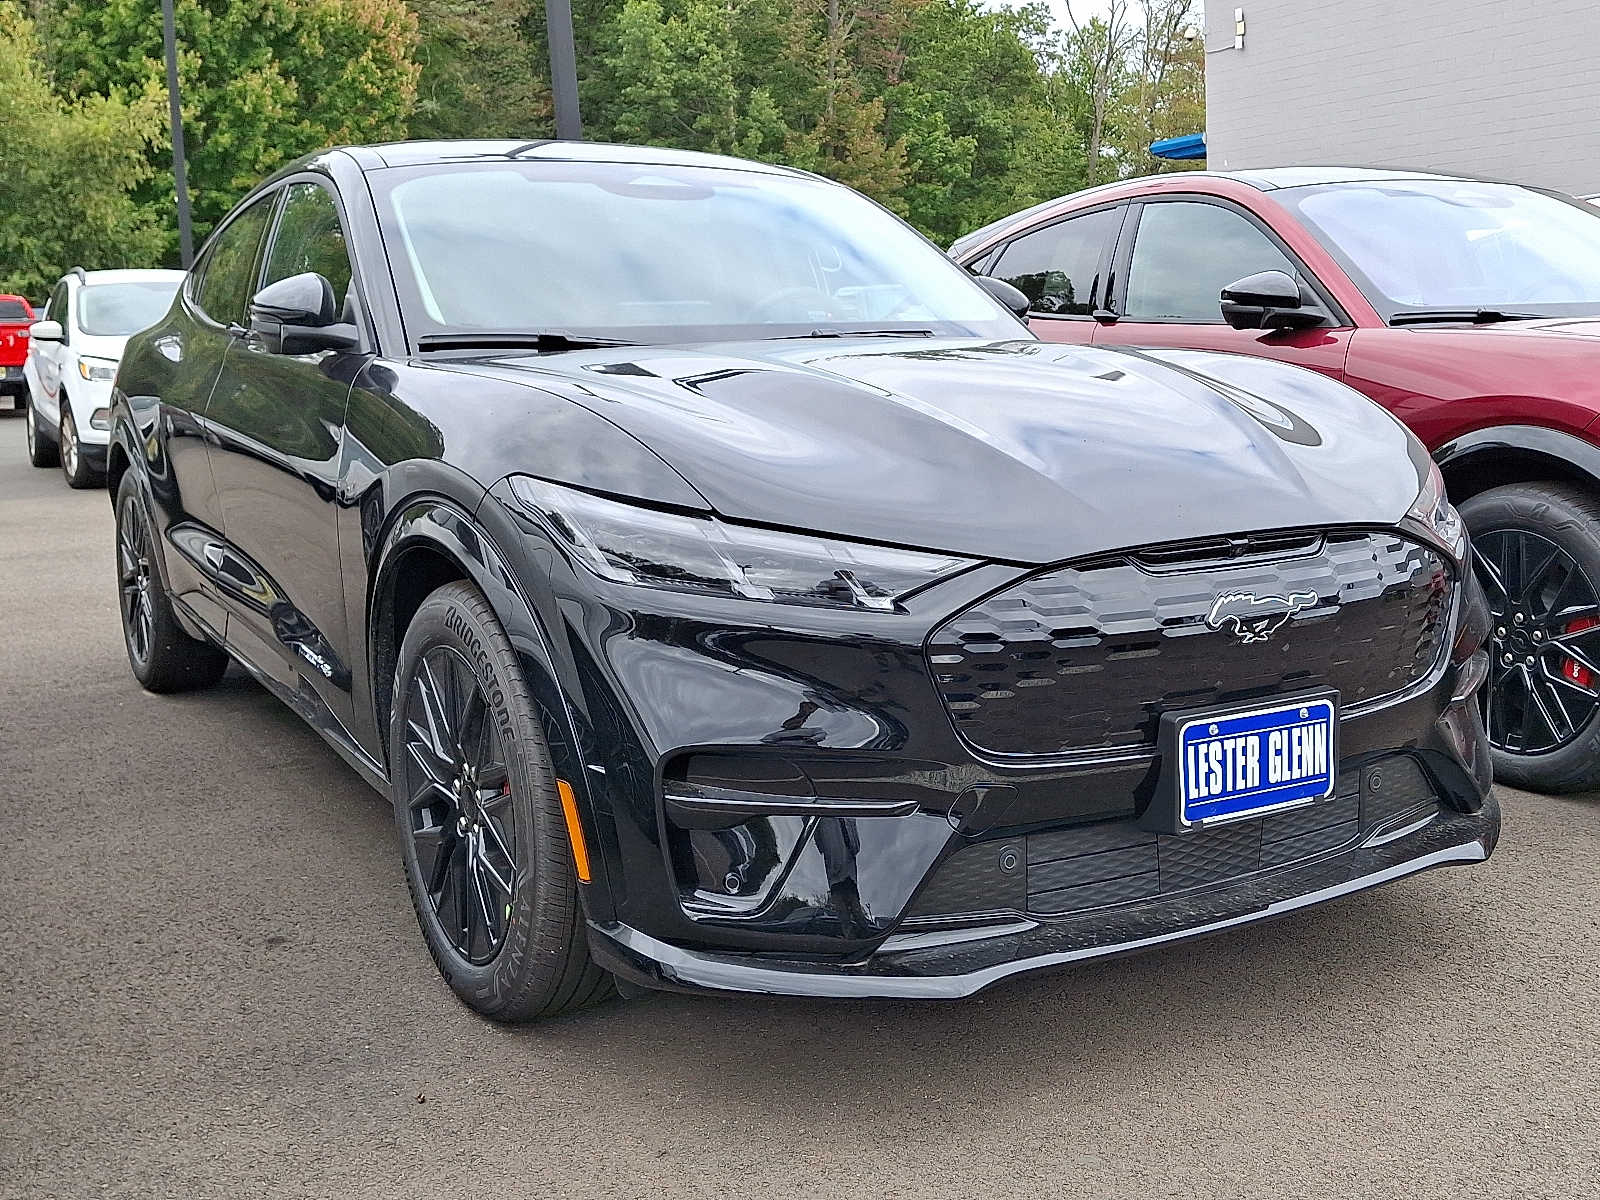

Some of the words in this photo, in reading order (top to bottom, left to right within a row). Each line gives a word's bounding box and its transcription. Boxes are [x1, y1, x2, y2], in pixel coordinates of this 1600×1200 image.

[444, 605, 515, 743] BRIDGESTONE
[1187, 735, 1260, 799] LESTER
[1268, 722, 1327, 784] GLENN
